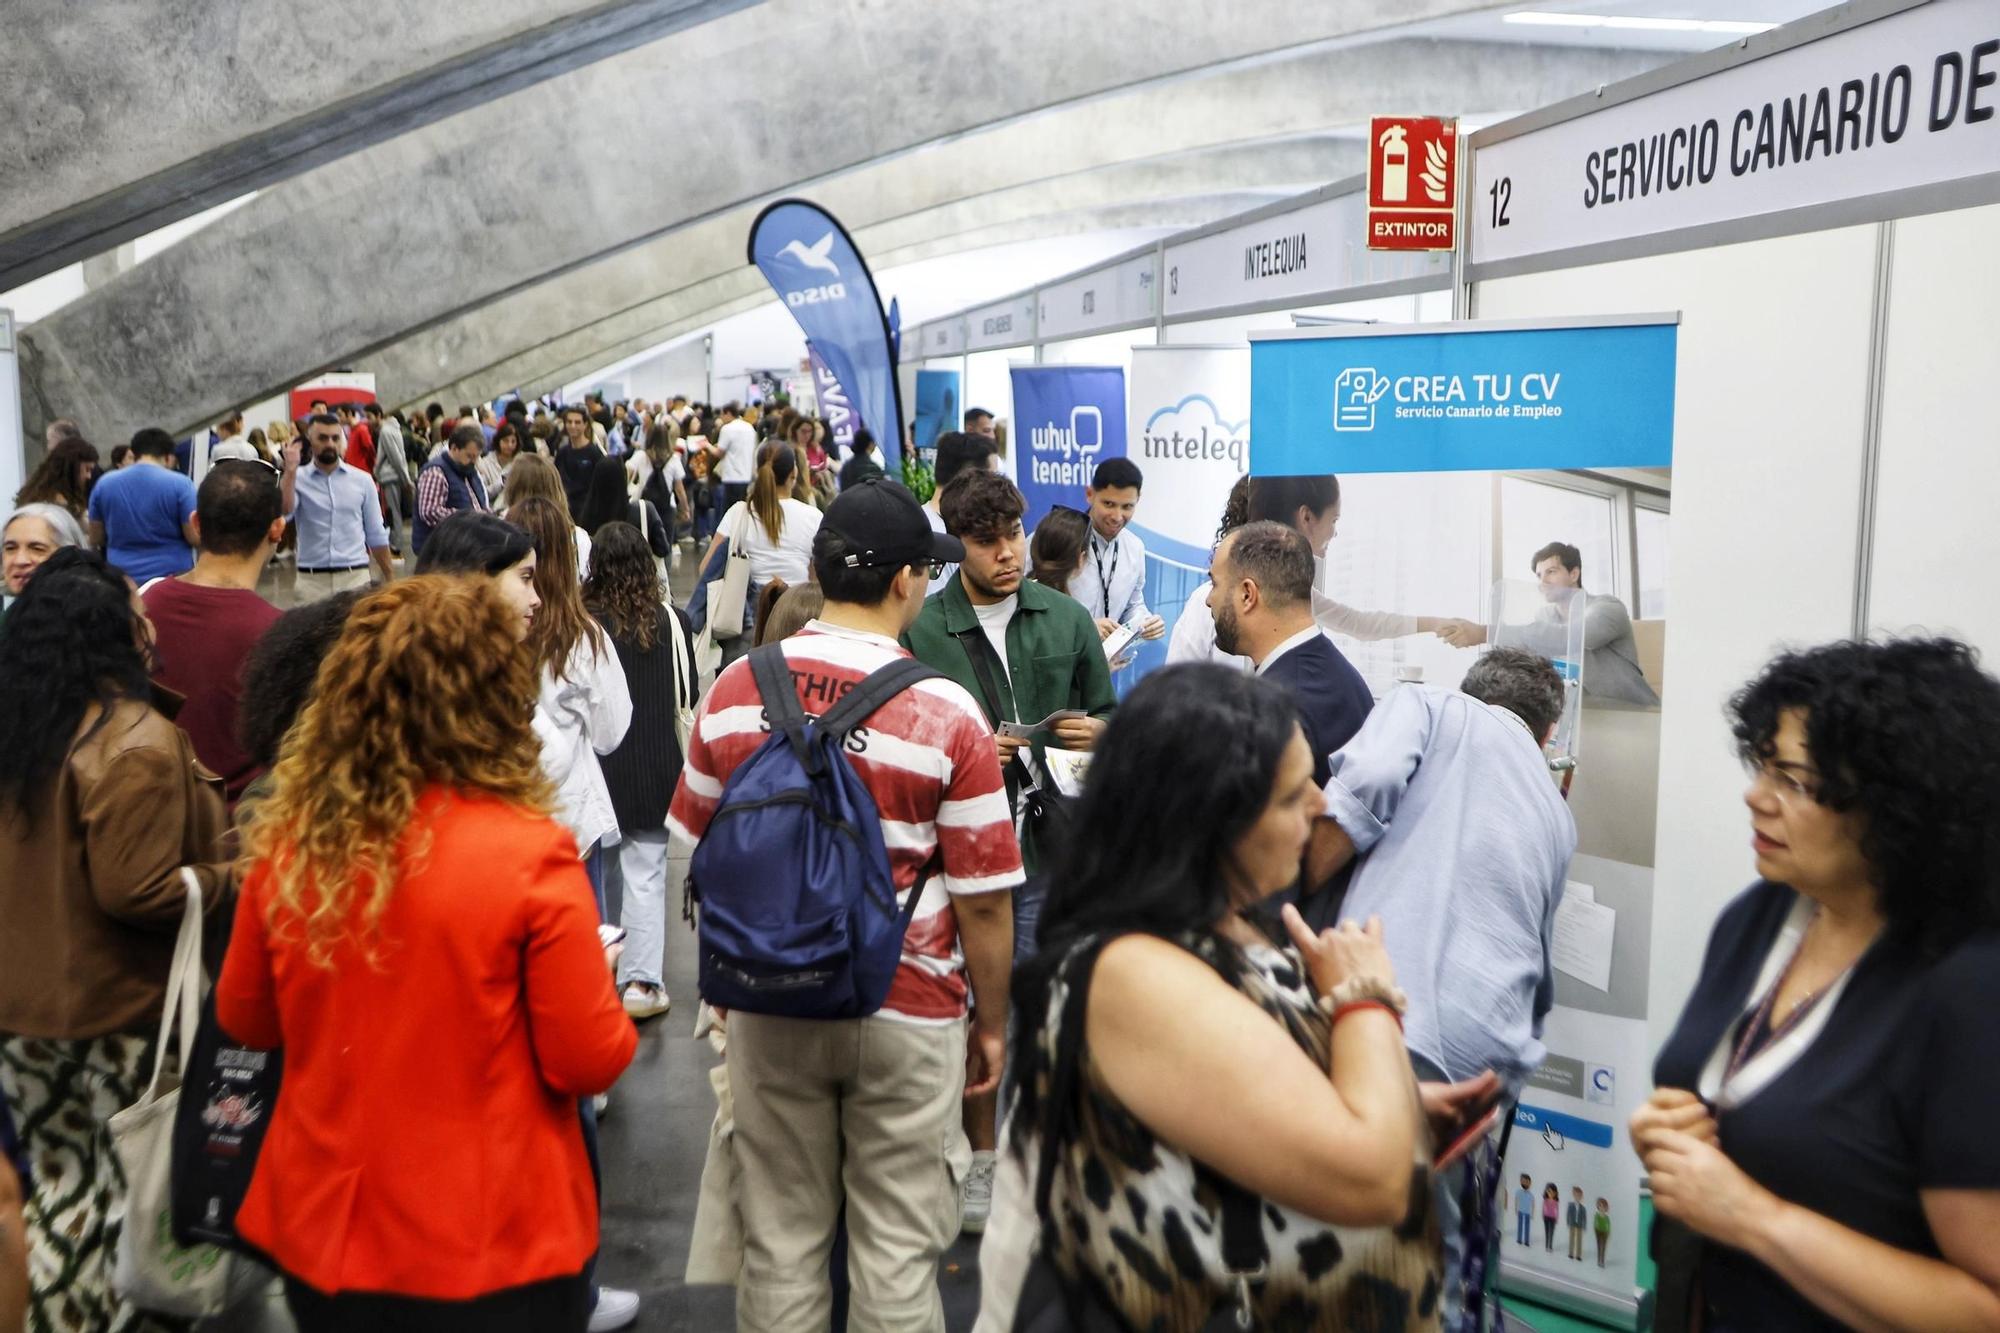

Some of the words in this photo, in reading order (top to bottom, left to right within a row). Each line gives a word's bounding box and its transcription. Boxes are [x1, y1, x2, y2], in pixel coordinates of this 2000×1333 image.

[1584, 118, 1719, 208] SERVICIO
[1730, 63, 1912, 177] CANARIO
[1928, 38, 2000, 133] DE
[1489, 177, 1512, 229] 12
[1374, 222, 1448, 237] EXTINTOR
[1244, 232, 1307, 281] INTELEQUIA
[1394, 375, 1466, 402] CREA
[1472, 373, 1512, 401] TU
[1520, 372, 1561, 401] CV
[1395, 405, 1443, 418] Servicio
[1446, 404, 1492, 417] Canario
[1495, 404, 1510, 417] de
[1513, 403, 1562, 420] Empleo
[1031, 420, 1072, 460] why
[1143, 426, 1251, 473] inteleq
